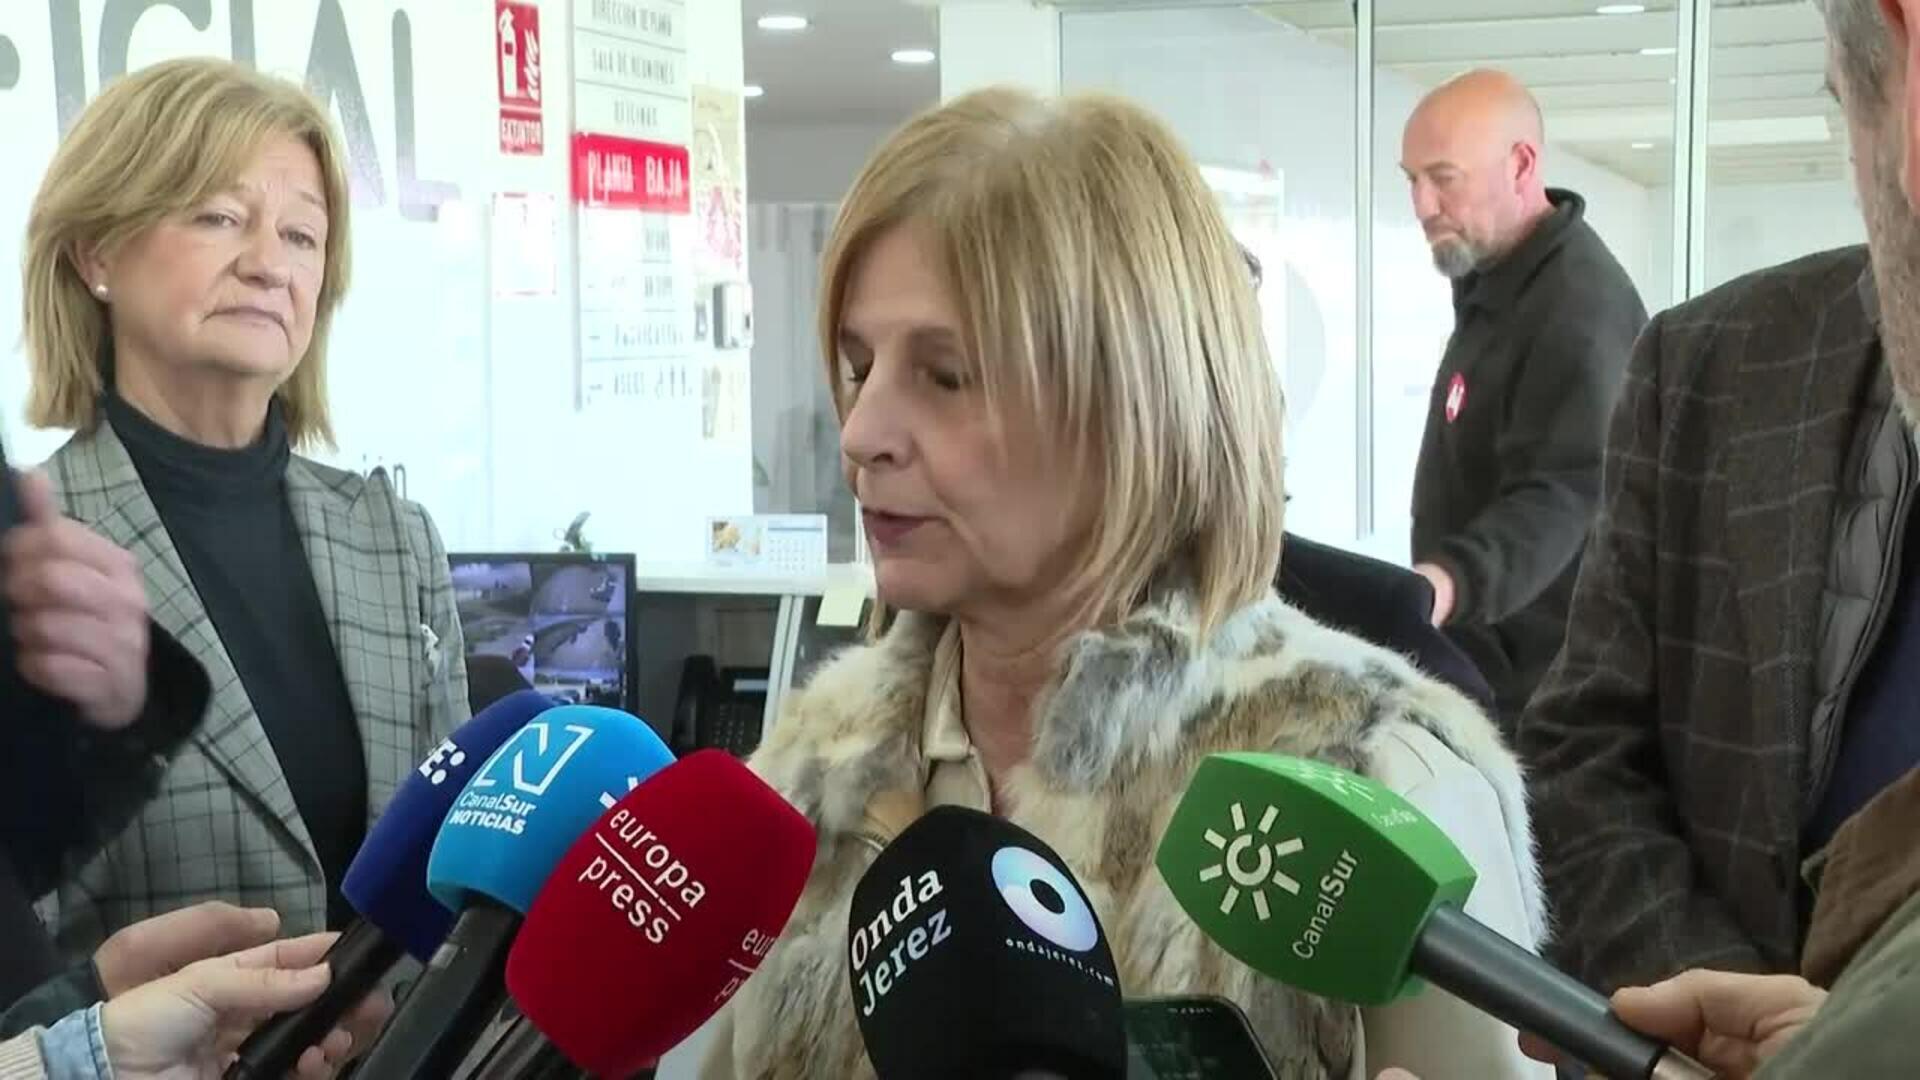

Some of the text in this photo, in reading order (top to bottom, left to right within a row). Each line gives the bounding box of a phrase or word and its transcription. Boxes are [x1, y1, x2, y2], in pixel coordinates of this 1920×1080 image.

[588, 150, 683, 198] PLANTA BAJA
[449, 809, 527, 835] NOTICIAS
[460, 791, 536, 817] CanalSur
[578, 856, 670, 944] press
[609, 808, 706, 909] europa
[851, 869, 943, 973] Onda
[1292, 848, 1359, 959] CanalSur
[859, 908, 953, 1016] Jerez
[1005, 938, 1115, 987] ondajerez.com
